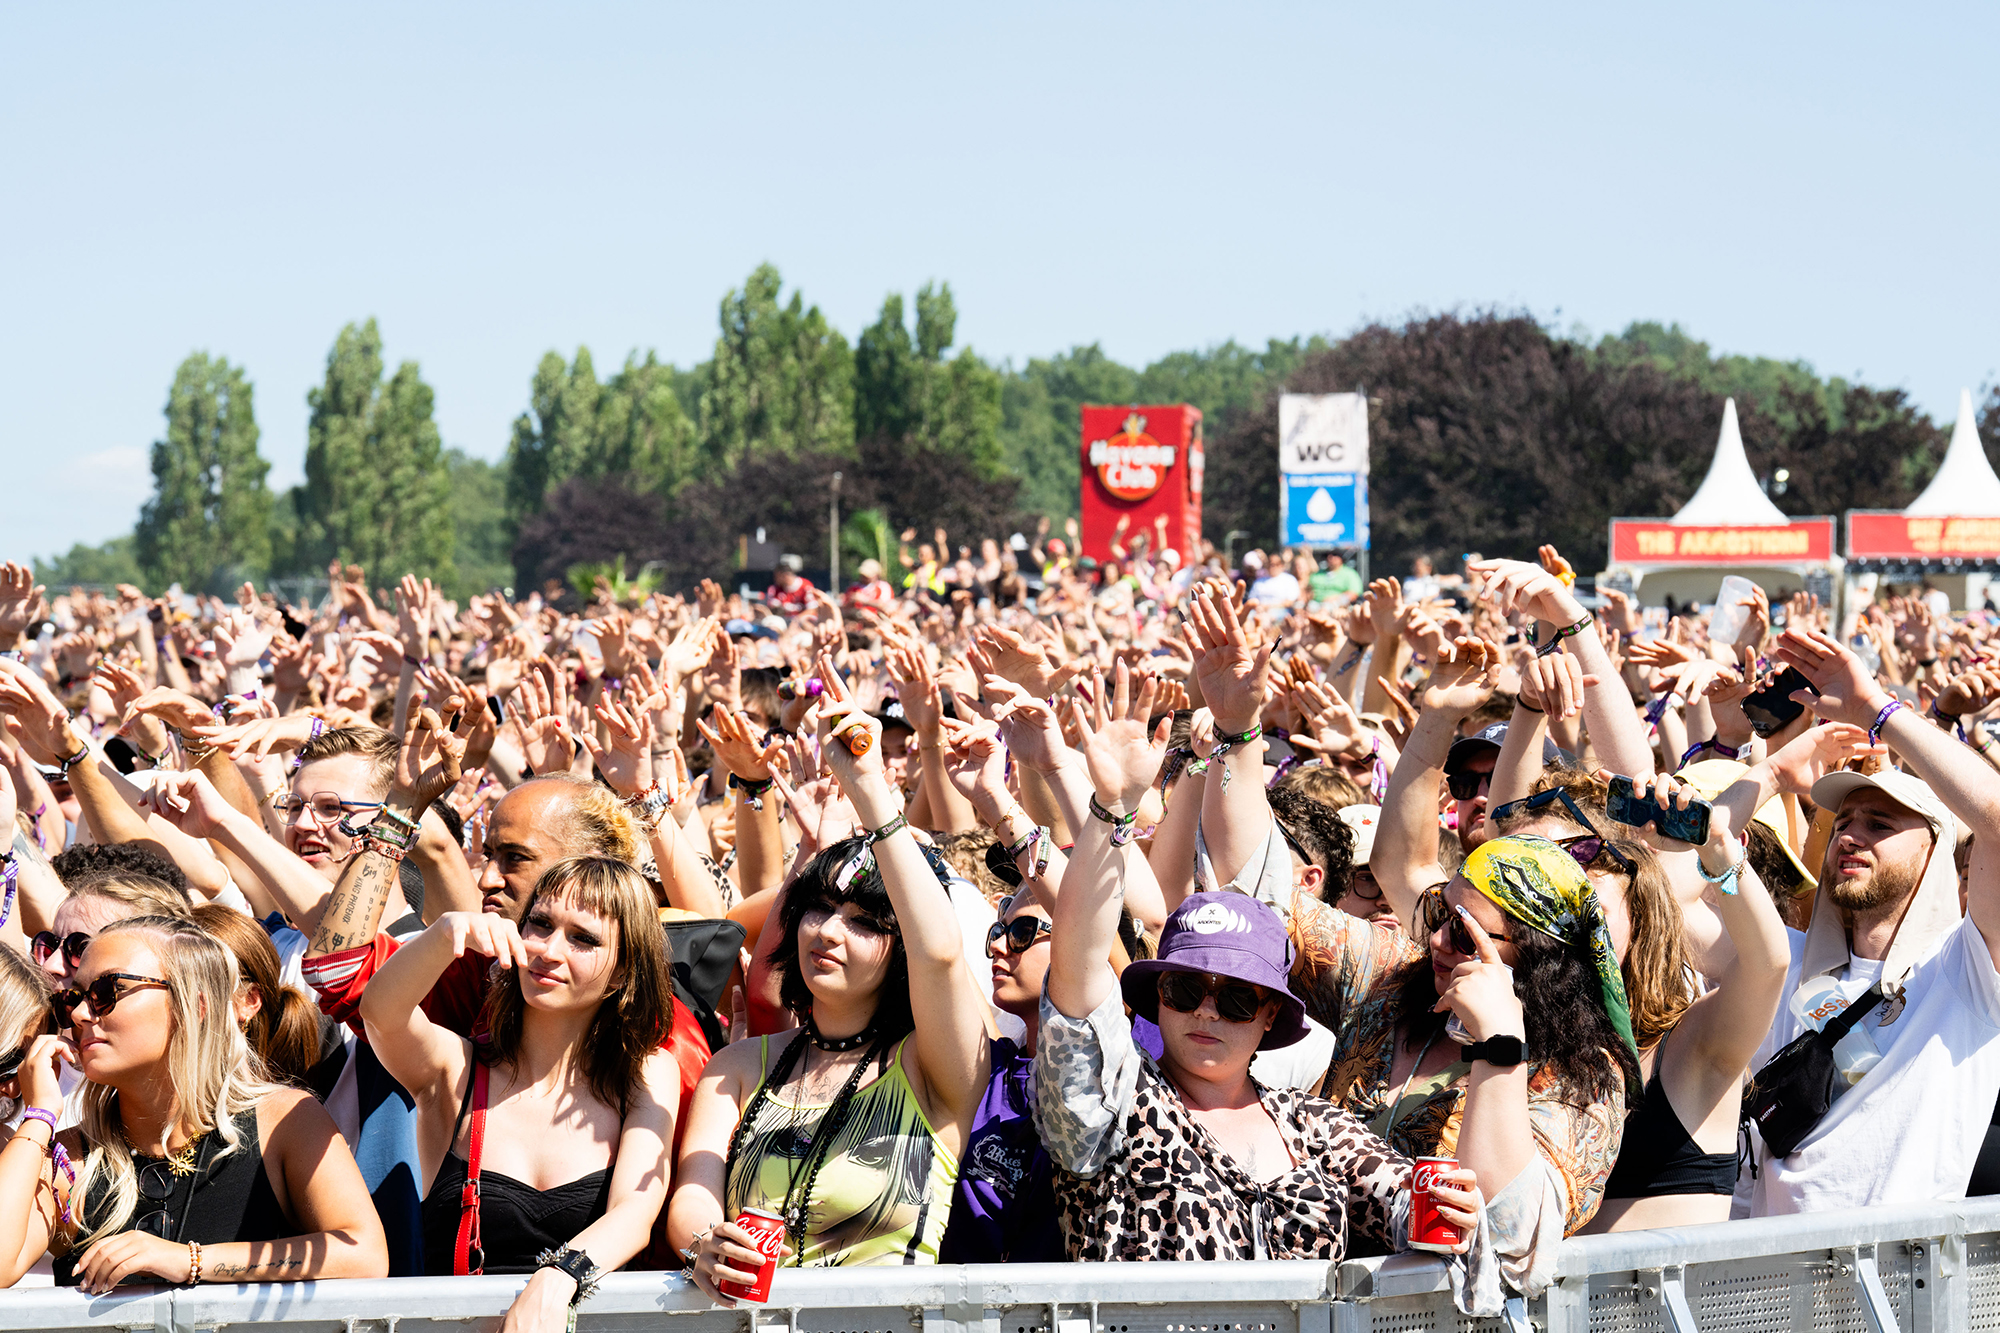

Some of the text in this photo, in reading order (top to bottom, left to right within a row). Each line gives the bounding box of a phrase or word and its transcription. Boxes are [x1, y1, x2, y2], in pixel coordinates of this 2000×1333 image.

[1297, 443, 1345, 462] WC
[1106, 466, 1157, 489] Club
[351, 876, 363, 895] KING
[342, 895, 358, 925] PHOENIX
[1809, 1003, 1838, 1021] les
[1759, 1103, 1777, 1122] EASTPAK
